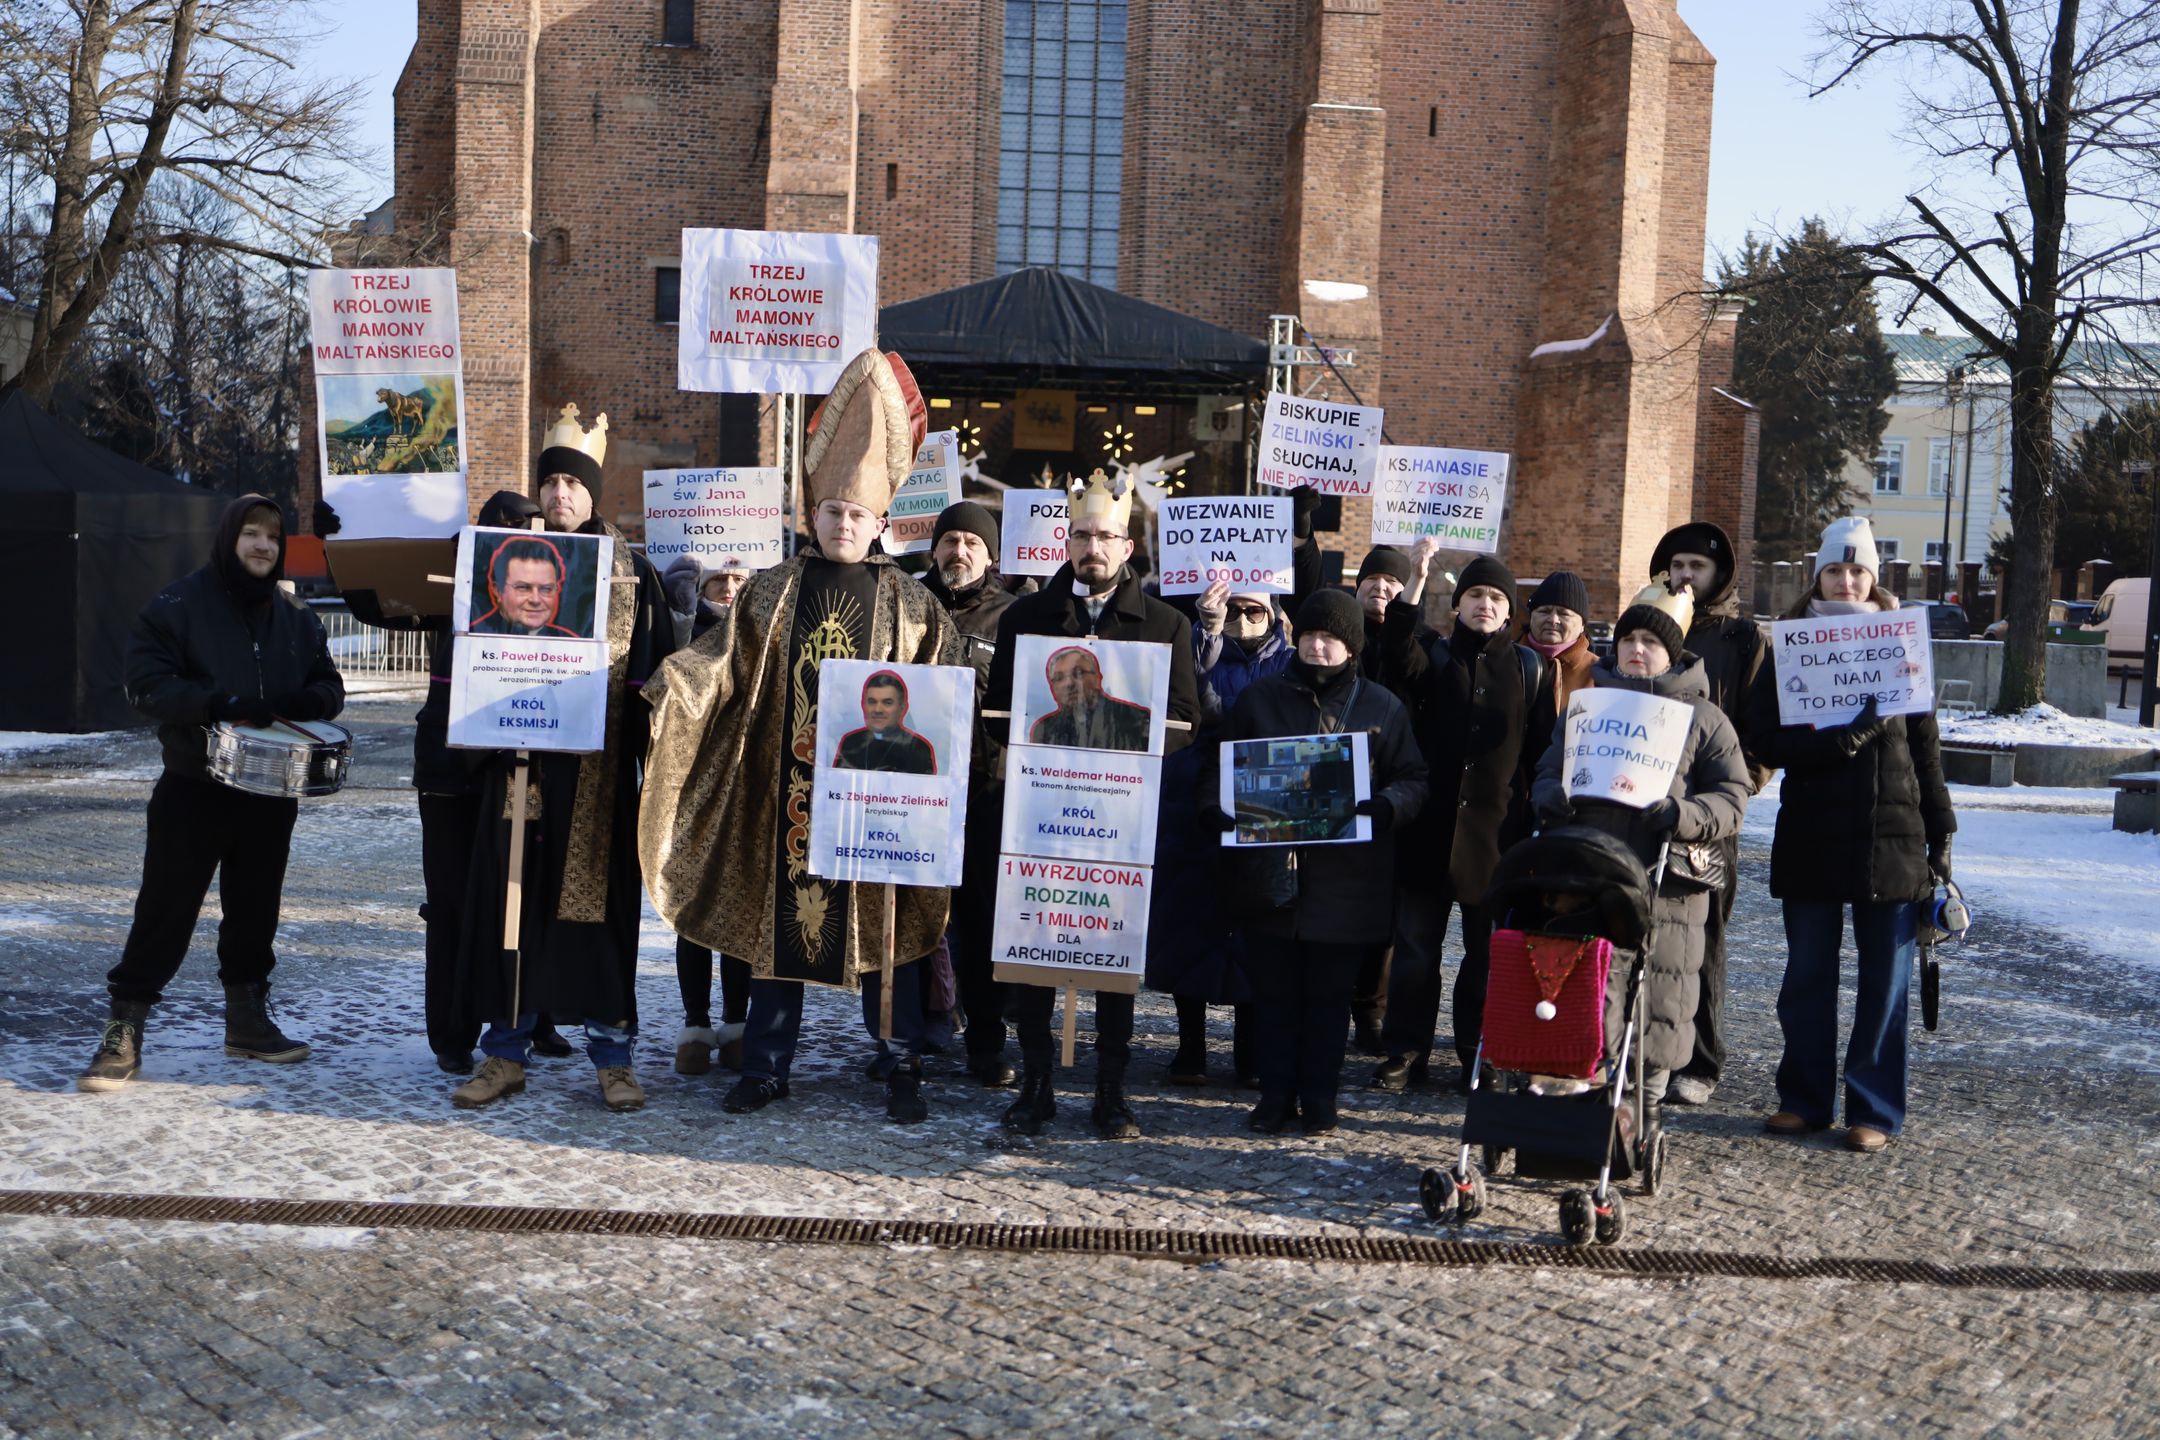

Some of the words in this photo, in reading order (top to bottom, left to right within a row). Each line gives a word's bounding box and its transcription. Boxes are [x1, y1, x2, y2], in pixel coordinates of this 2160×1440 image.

[750, 264, 805, 281] TRZEJ
[350, 275, 410, 290] TRZEJ
[729, 284, 823, 304] KRÓLOWIE
[333, 295, 432, 314] KRÓLOWIE
[736, 309, 815, 326] MAMONY
[342, 322, 425, 337] MAMONY
[709, 328, 840, 349] MALTAŃSKIEGO
[317, 341, 454, 359] MALTAŃSKIEGO
[1279, 401, 1360, 427] BISKUPIE
[917, 450, 936, 464] CĘ
[1272, 447, 1357, 476] SŁUCHAJ,
[1262, 467, 1285, 485] NIE
[1388, 458, 1489, 478] KS.HANASIE
[676, 470, 737, 486] parafia
[902, 470, 942, 486] STAĆ
[673, 488, 701, 501] św.
[706, 488, 746, 500] Jana
[1384, 480, 1413, 494] CZY
[1416, 481, 1463, 497] ZYSKI
[1468, 485, 1490, 503] SĄ
[646, 505, 779, 519] Jerozolimskiego
[895, 502, 906, 512] W
[909, 497, 944, 510] MOIM
[1168, 503, 1275, 521] WEZWANIE
[1386, 498, 1484, 520] WAŻNIEJSZE
[683, 523, 724, 535] kato
[899, 521, 934, 535] DOM
[1166, 529, 1194, 545] DO
[1200, 528, 1288, 543] ZAPŁATY
[1397, 521, 1496, 541] PARAFIANIE?
[647, 540, 764, 555] deweloperem
[769, 539, 780, 551] ?
[1017, 547, 1069, 561] EKSMI
[1211, 550, 1237, 562] NA
[1163, 570, 1199, 585] 225
[1206, 568, 1274, 586] 000,00
[1785, 621, 1917, 646] KS.DESKURZE
[482, 650, 498, 660] ks.
[501, 651, 538, 661] Paweł
[541, 652, 583, 663] Deskur
[1801, 646, 1906, 667] DLACZEGO
[472, 664, 512, 673] proboszcz
[513, 666, 540, 674] parafii
[556, 667, 569, 675] św.
[1834, 670, 1881, 686] NAM
[498, 676, 562, 686] Jerozolimskiego
[511, 697, 546, 711] KRÓL
[1798, 697, 1826, 710] TO
[1832, 690, 1900, 707] ROBSZ
[499, 716, 559, 729] EKSMISJI
[1575, 718, 1648, 742] KURIA
[1565, 744, 1675, 772] EVELOPMENT
[1021, 765, 1038, 775] ks.
[1040, 767, 1102, 781] Waldemar
[1105, 773, 1143, 784] Hanas
[1031, 781, 1064, 790] Ekonom
[1065, 784, 1131, 797] Archidiecezjalny
[828, 790, 844, 800] ks.
[847, 792, 898, 805] Zbigniew
[901, 795, 948, 807] Zieliński
[865, 808, 908, 818] Arcybiskup
[1062, 806, 1096, 820] KRÓL
[868, 829, 901, 843] KRÓL
[1038, 823, 1118, 839] KALKULACJI
[835, 846, 935, 863] BEZCZYNNOŚCI
[1005, 860, 1012, 875] 1
[1019, 861, 1144, 887] WYRZUCONA
[1024, 886, 1110, 908] RODZINA
[1036, 911, 1043, 925] 1
[1048, 912, 1109, 930] MILION
[1057, 933, 1081, 945] DLA
[1006, 945, 1129, 968] ARCHIDIECEZJI
